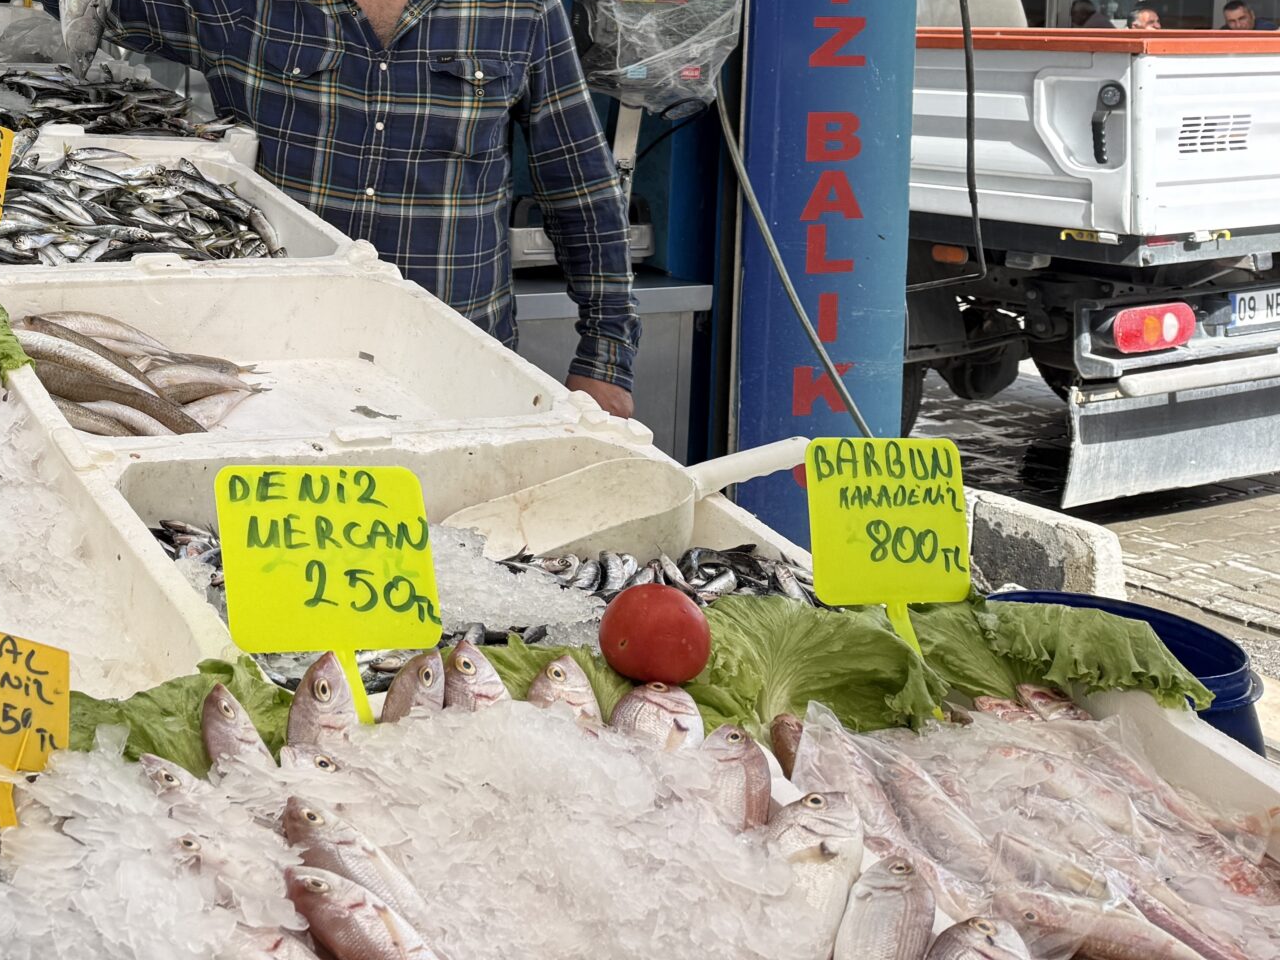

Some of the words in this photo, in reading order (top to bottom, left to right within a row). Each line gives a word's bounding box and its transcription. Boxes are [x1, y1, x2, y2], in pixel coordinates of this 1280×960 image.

[792, 111, 863, 487] BALIK
[1238, 295, 1257, 321] 09
[813, 438, 953, 481] BARBUN
[246, 513, 429, 551] MERCAN
